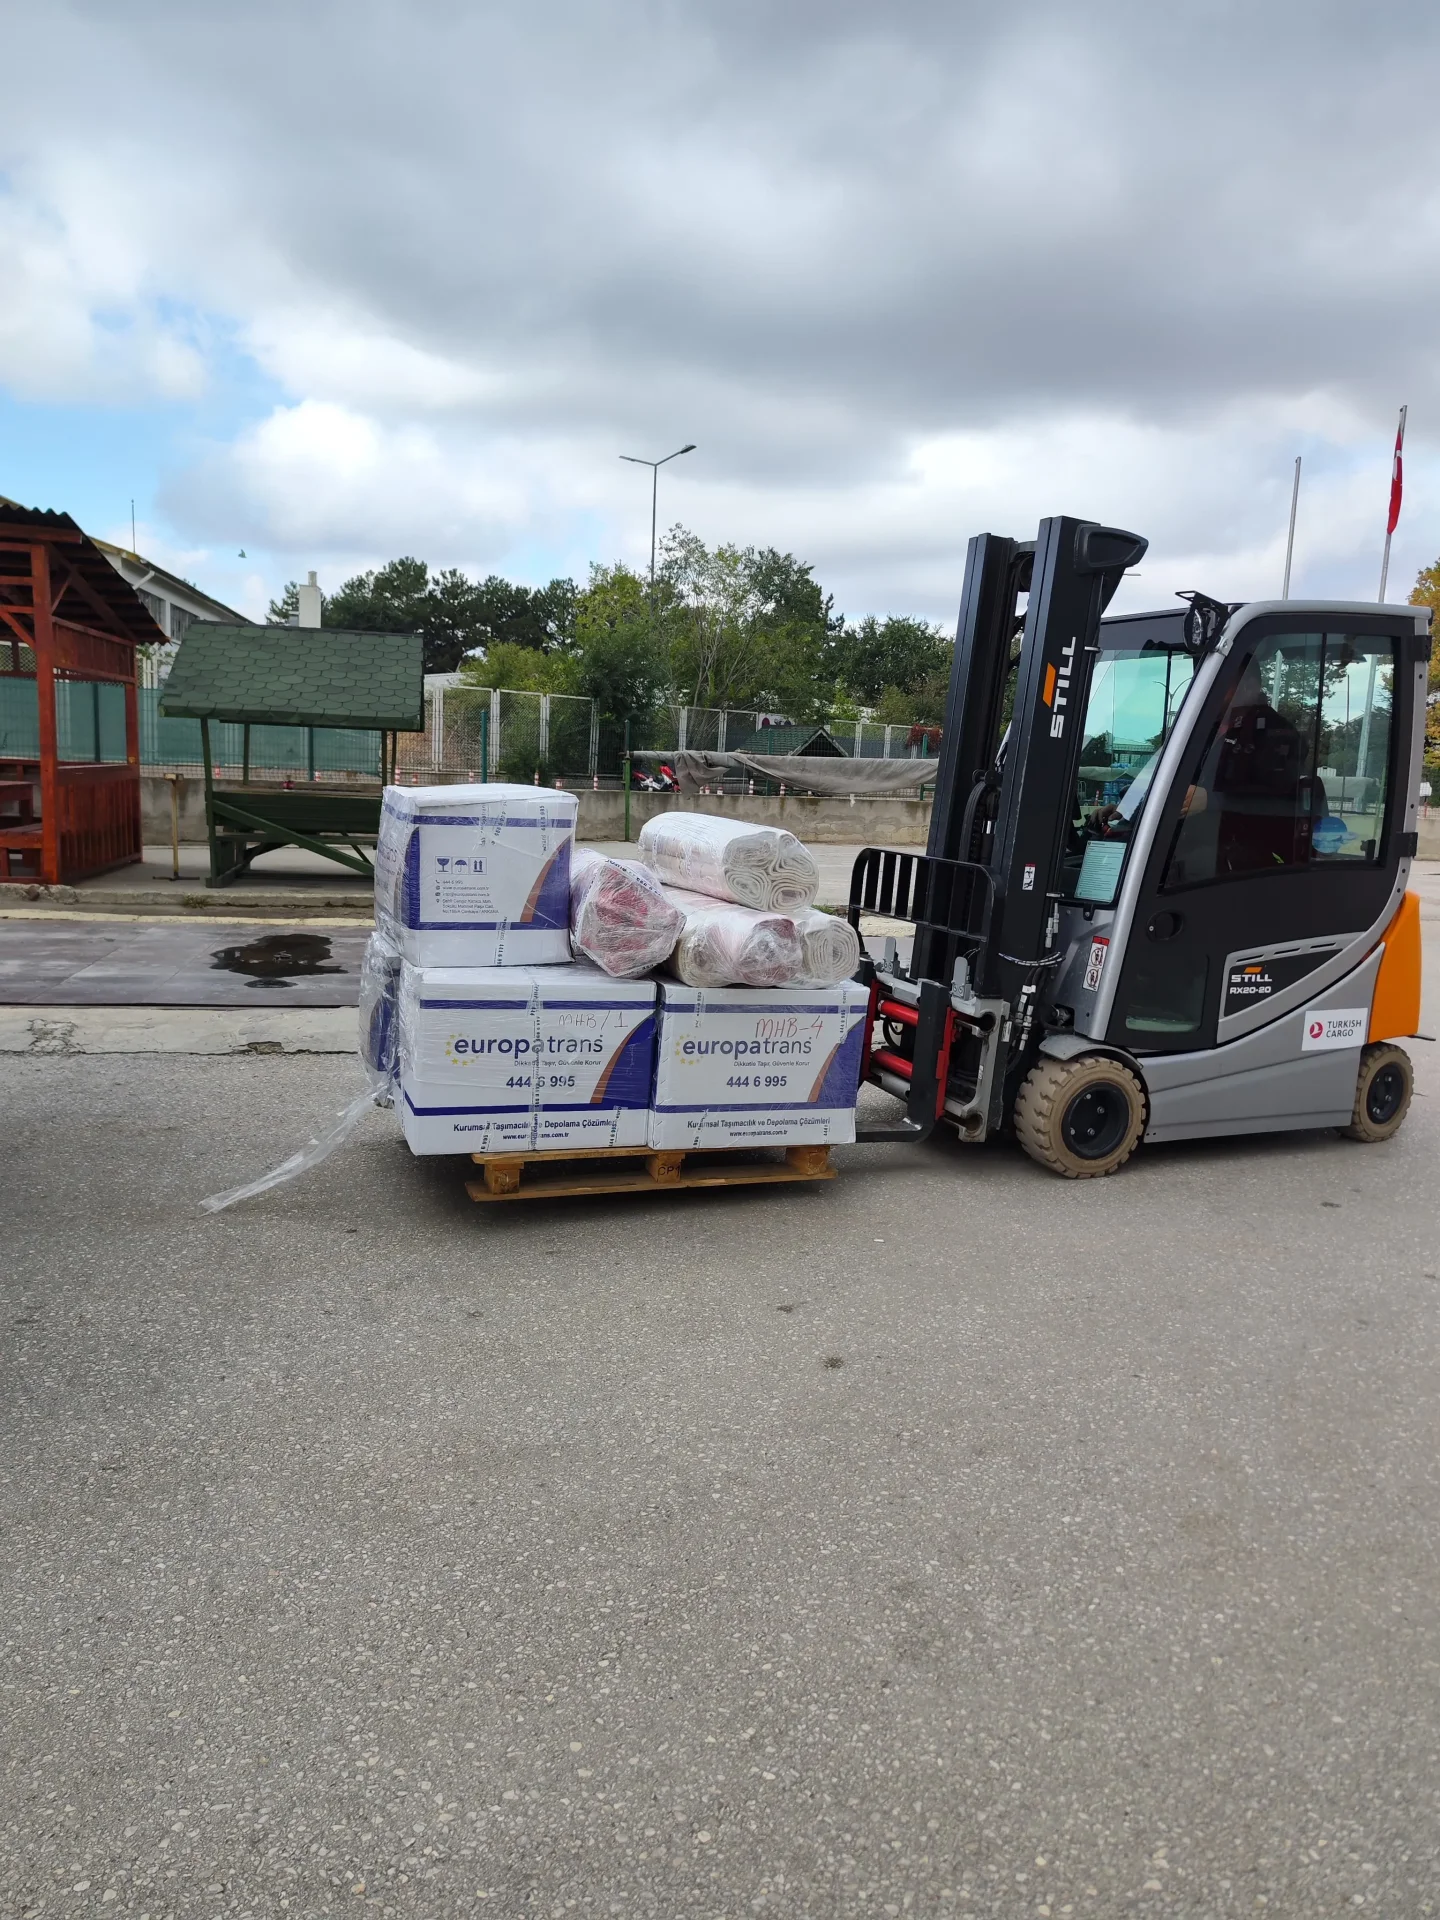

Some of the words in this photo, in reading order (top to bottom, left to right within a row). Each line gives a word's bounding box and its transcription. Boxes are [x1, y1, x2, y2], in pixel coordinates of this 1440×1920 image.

[1050, 636, 1077, 739] STILL
[1231, 974, 1273, 983] STILL
[1229, 985, 1272, 995] RX20-20
[1327, 1020, 1362, 1029] TURKISH
[1326, 1029, 1354, 1038] CARGO
[454, 1035, 603, 1059] europatrans
[682, 1038, 812, 1060] europatrans
[506, 1076, 532, 1088] 444
[537, 1076, 546, 1088] 6
[550, 1076, 576, 1088] 995
[726, 1076, 750, 1088] 444
[753, 1076, 761, 1088] 6
[764, 1075, 788, 1087] 995
[544, 1120, 581, 1129] Depolama
[720, 1118, 757, 1128] Taşımacılık
[766, 1118, 798, 1127] Depolama
[799, 1116, 831, 1127] Çözümleri
